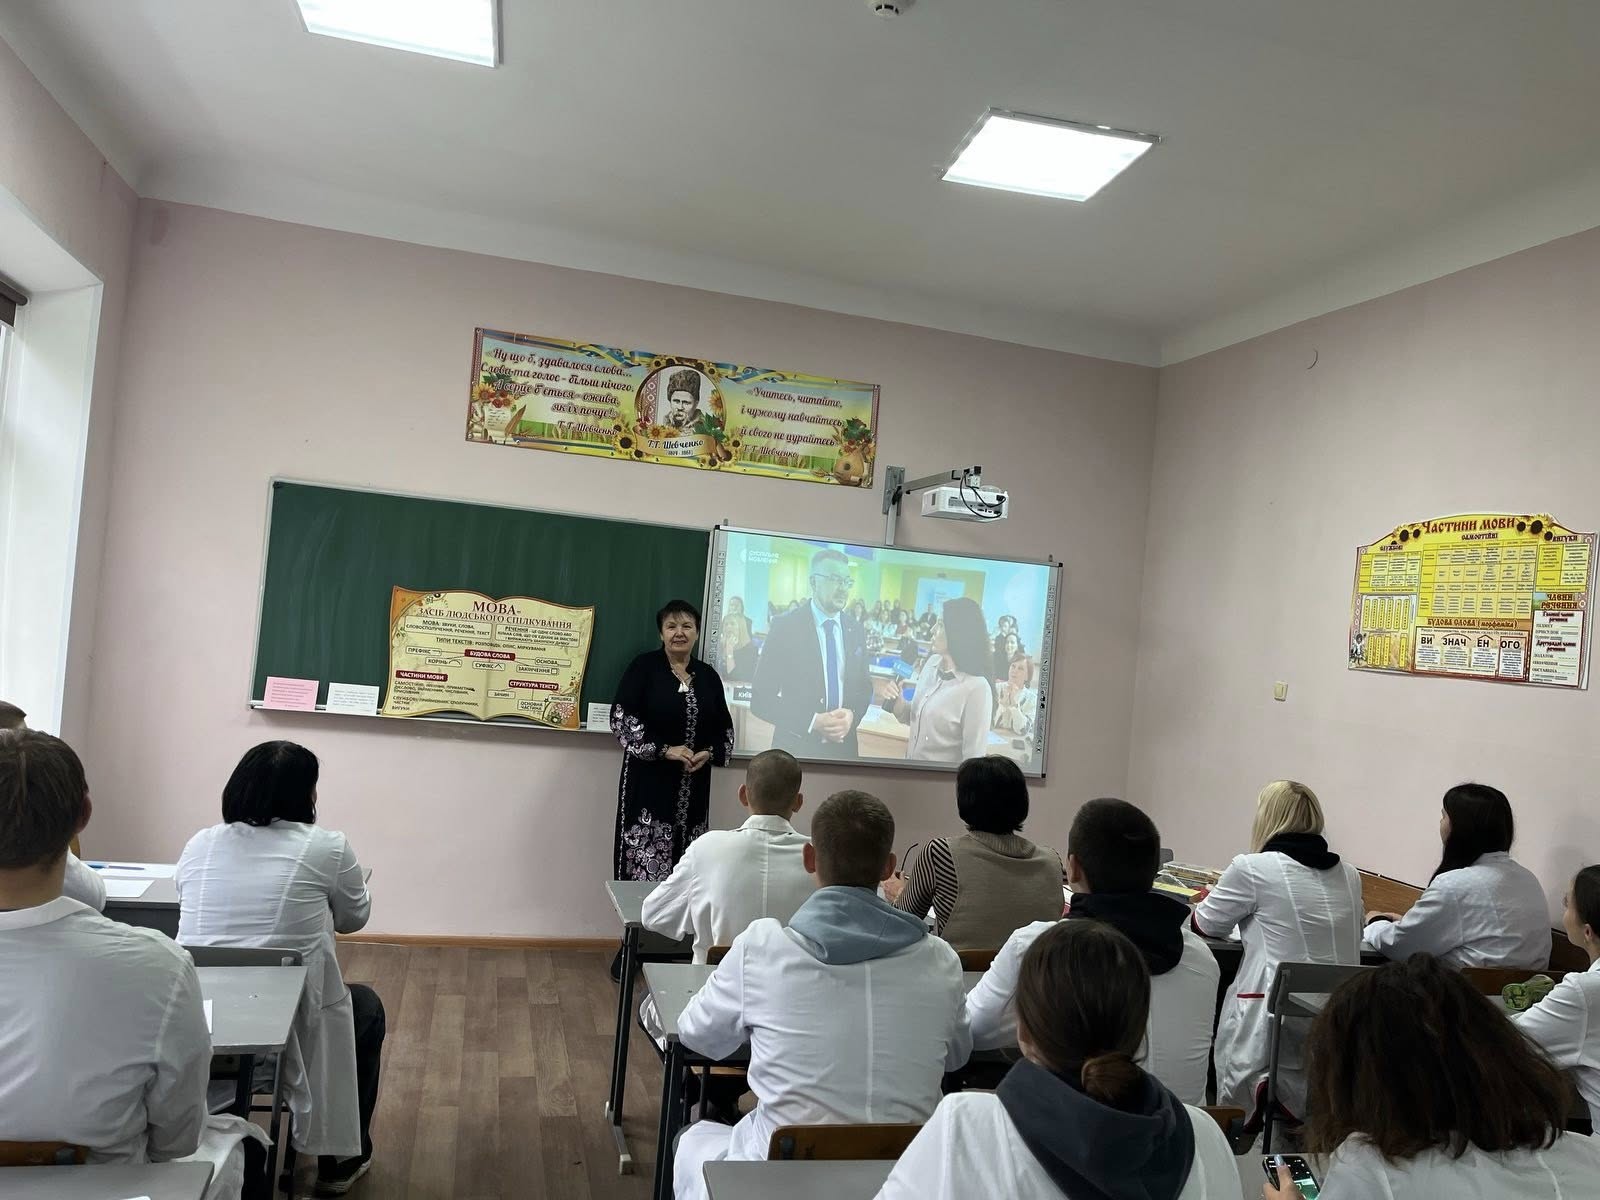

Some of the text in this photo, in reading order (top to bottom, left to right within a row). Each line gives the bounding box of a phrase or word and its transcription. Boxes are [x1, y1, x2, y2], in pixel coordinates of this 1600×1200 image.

[510, 353, 526, 363] що
[538, 357, 592, 371] здавалося
[532, 371, 561, 381] голос
[569, 374, 599, 388] більш
[505, 383, 532, 394] серце
[553, 404, 566, 412] як
[747, 407, 787, 422] чужому
[577, 423, 617, 435] Шевченко
[740, 425, 747, 435] й
[749, 427, 772, 438] свого
[774, 432, 785, 440] не
[663, 440, 704, 449] Шевченко
[419, 607, 572, 629] ЗАСІБ ЛЮДСЬКОГО СПІЛКУВАННЯ
[1427, 618, 1452, 626] БУДОВА
[436, 637, 452, 645] ТИПИ
[1421, 636, 1433, 644] ВИ
[1442, 638, 1467, 647] ЗНАЧ
[1477, 639, 1489, 648] ЕН
[1500, 640, 1520, 649] ОГО
[469, 650, 491, 658] БУДОВА
[399, 671, 426, 679] ЧАСТИНИ
[509, 681, 538, 689] СТРУКТУРА
